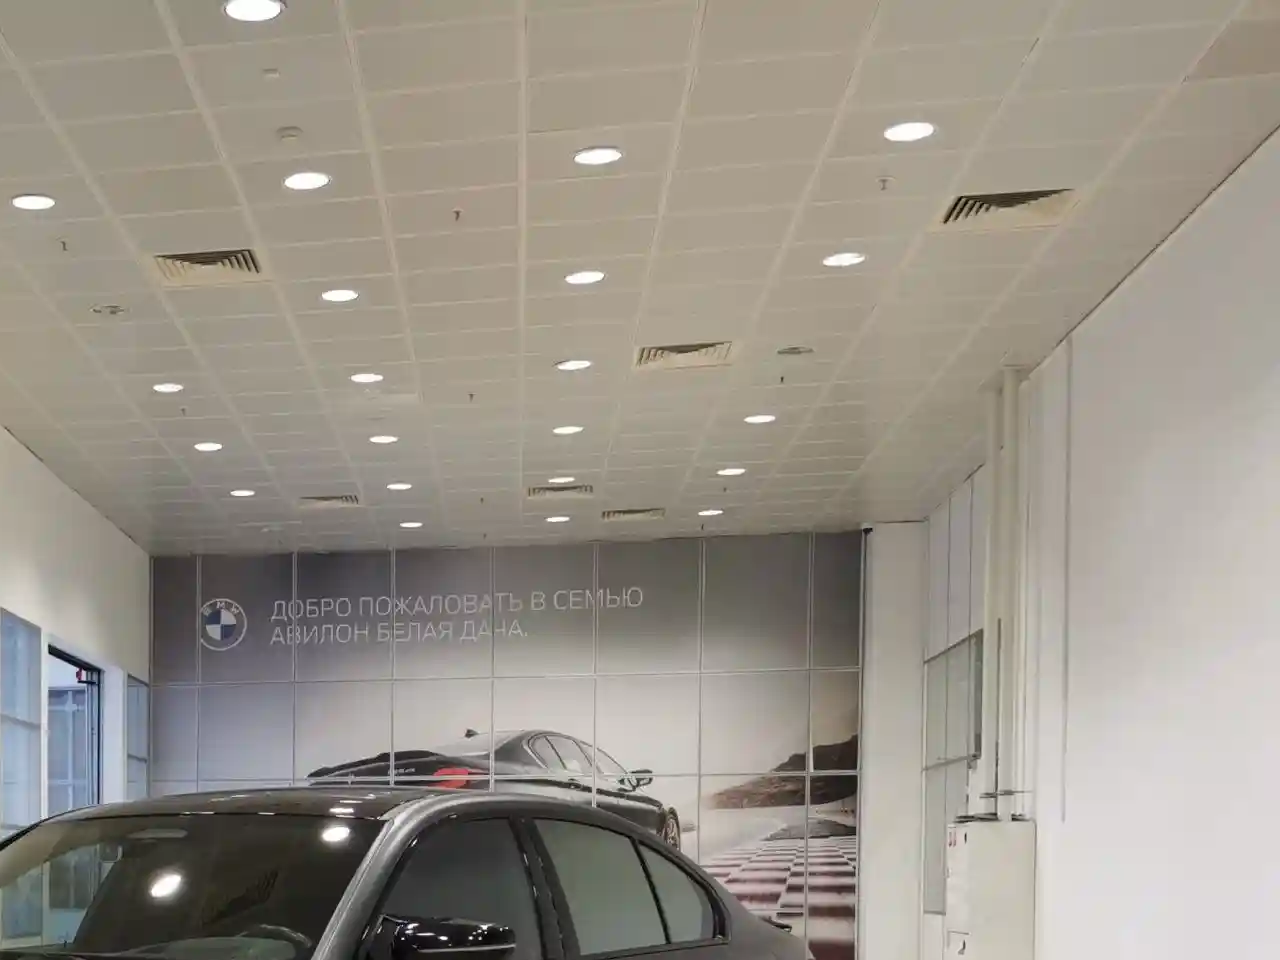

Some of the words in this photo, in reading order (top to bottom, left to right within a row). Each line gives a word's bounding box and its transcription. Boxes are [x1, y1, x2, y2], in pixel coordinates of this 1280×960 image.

[270, 598, 352, 622] ДОБРО
[359, 592, 524, 617] ПОЖАЛОВАТЬ
[530, 590, 547, 612] В
[553, 586, 644, 610] СЕМЬЮ
[270, 622, 370, 646] АВИЛОН
[377, 620, 454, 643] БЕЛАЯ
